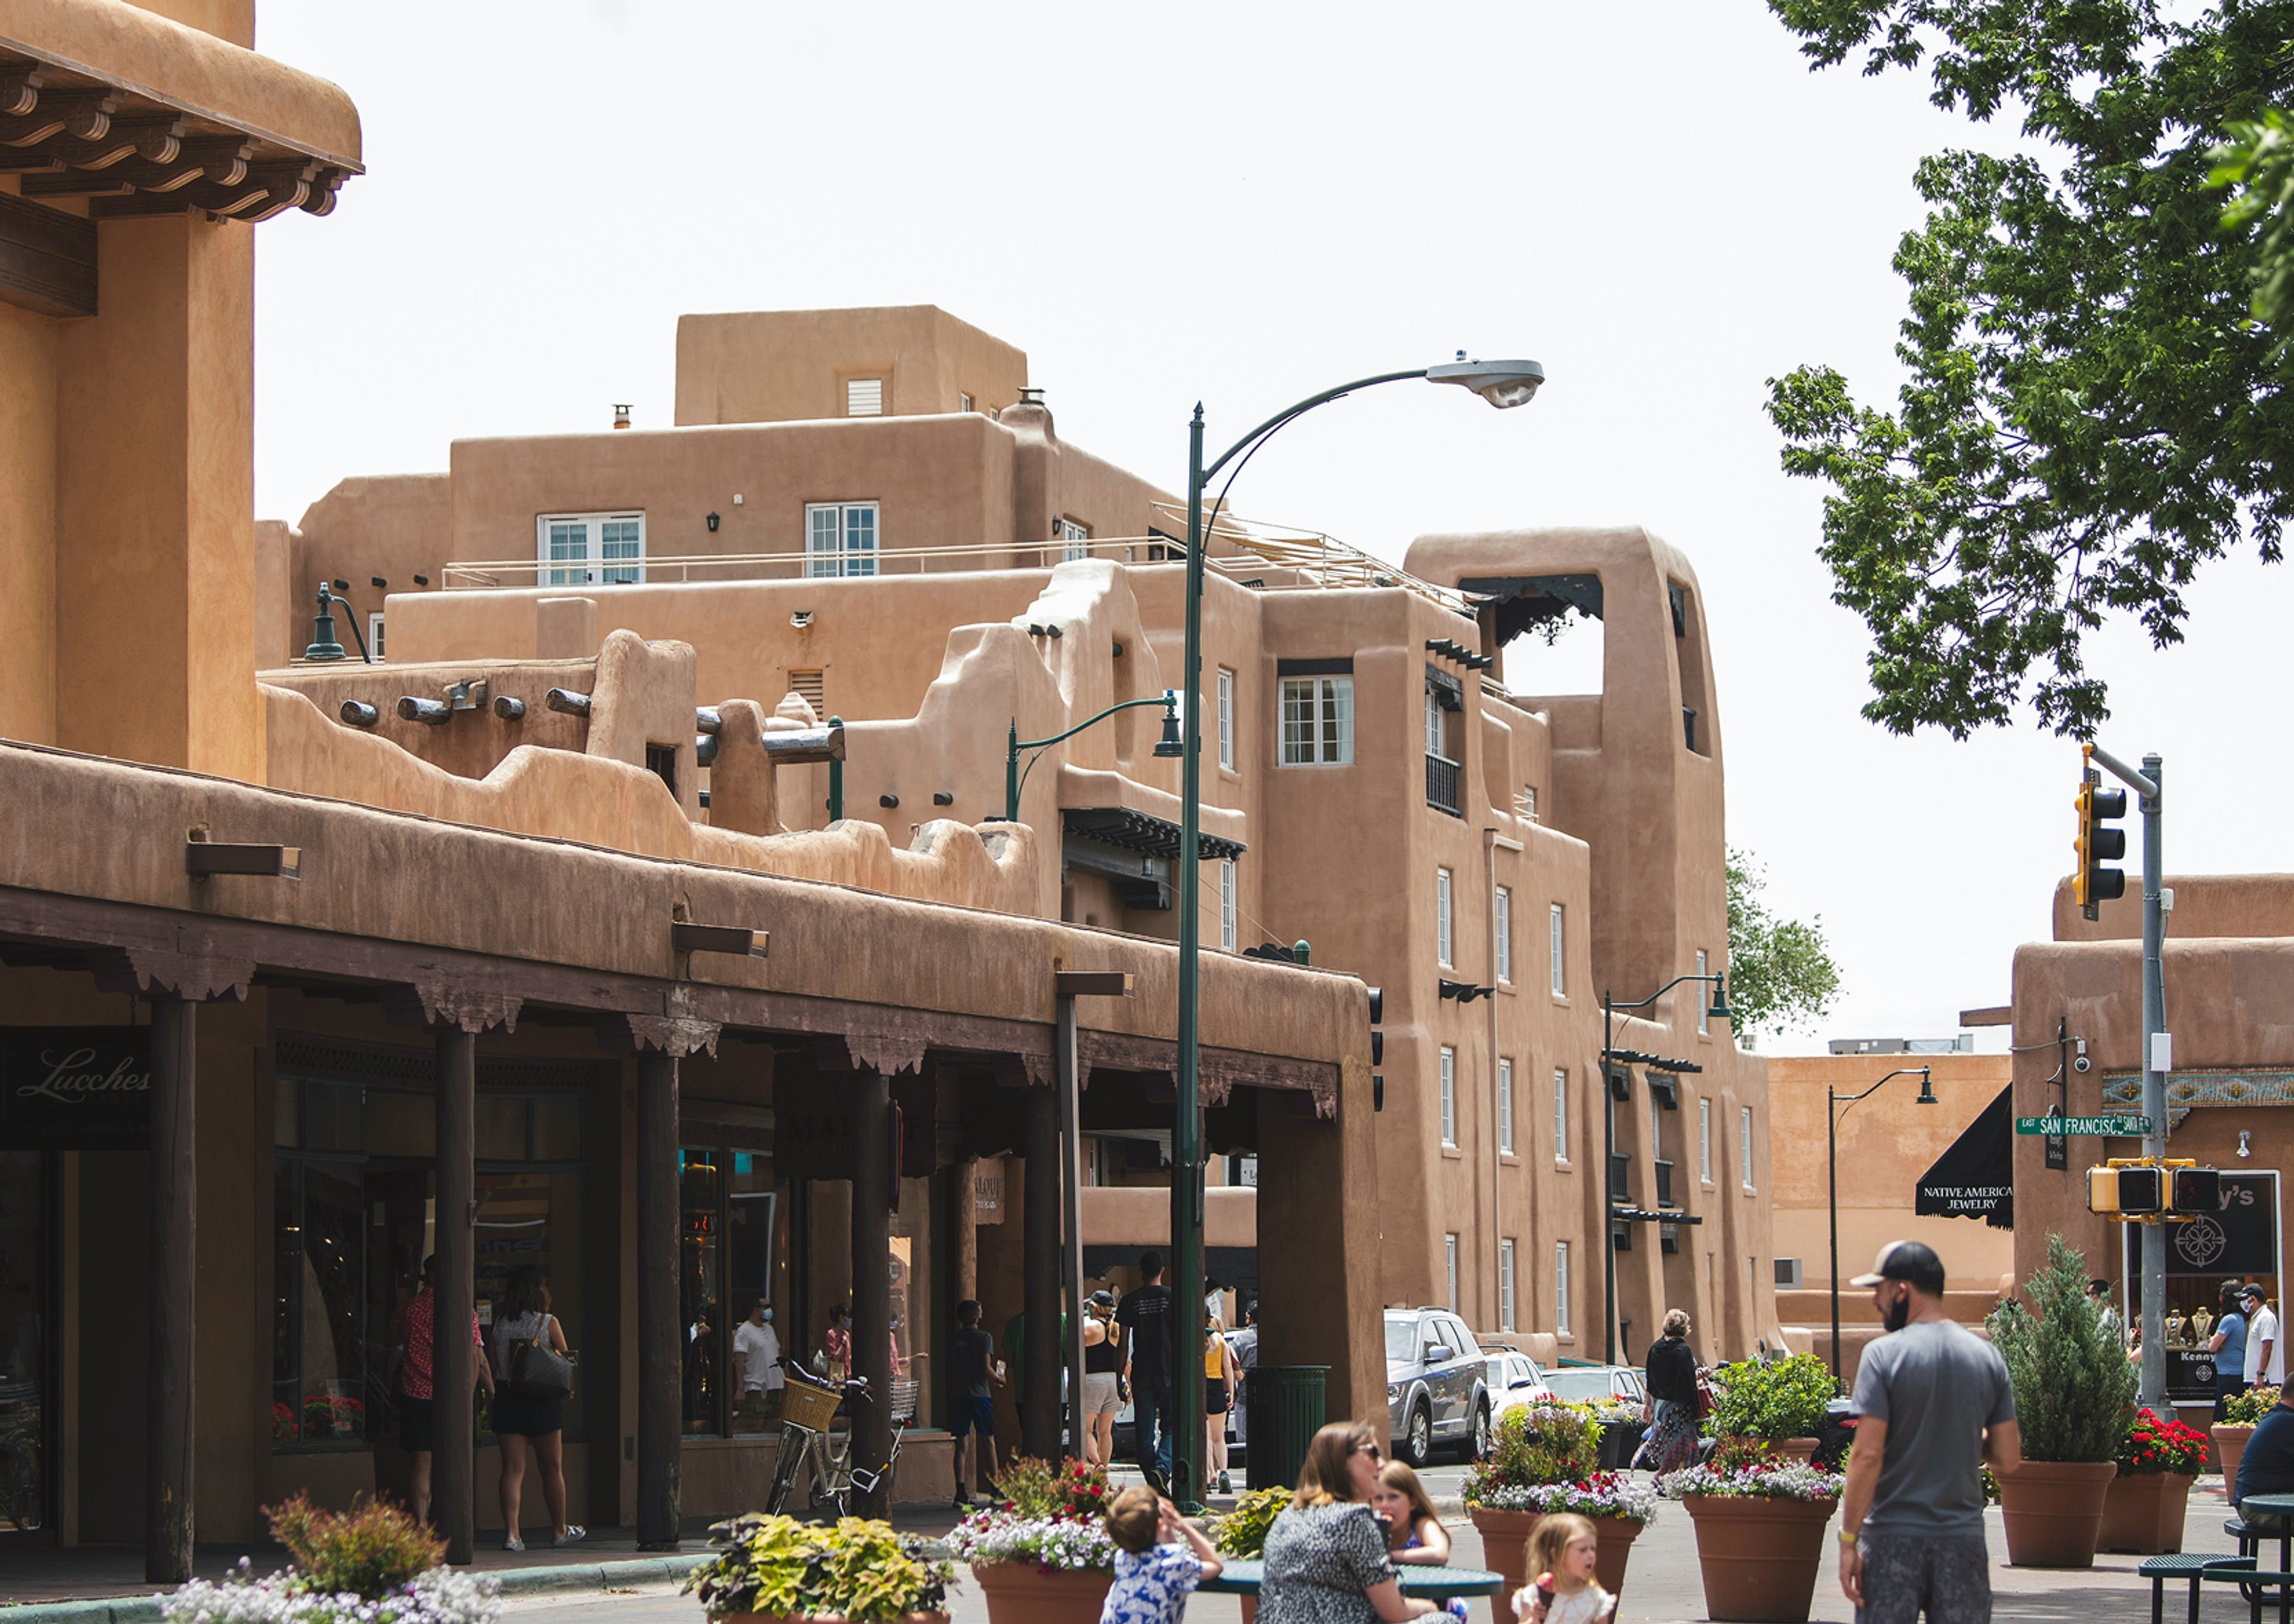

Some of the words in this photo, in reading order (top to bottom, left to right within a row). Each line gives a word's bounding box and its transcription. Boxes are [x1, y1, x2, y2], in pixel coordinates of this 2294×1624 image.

[785, 1116, 922, 1141] MALF
[2022, 1118, 2035, 1127] EAST
[2040, 1118, 2060, 1134] SAN
[2065, 1119, 2124, 1134] FRANCISC
[1924, 1187, 1963, 1198] NATIVE
[1947, 1199, 1998, 1209] JEWELRY
